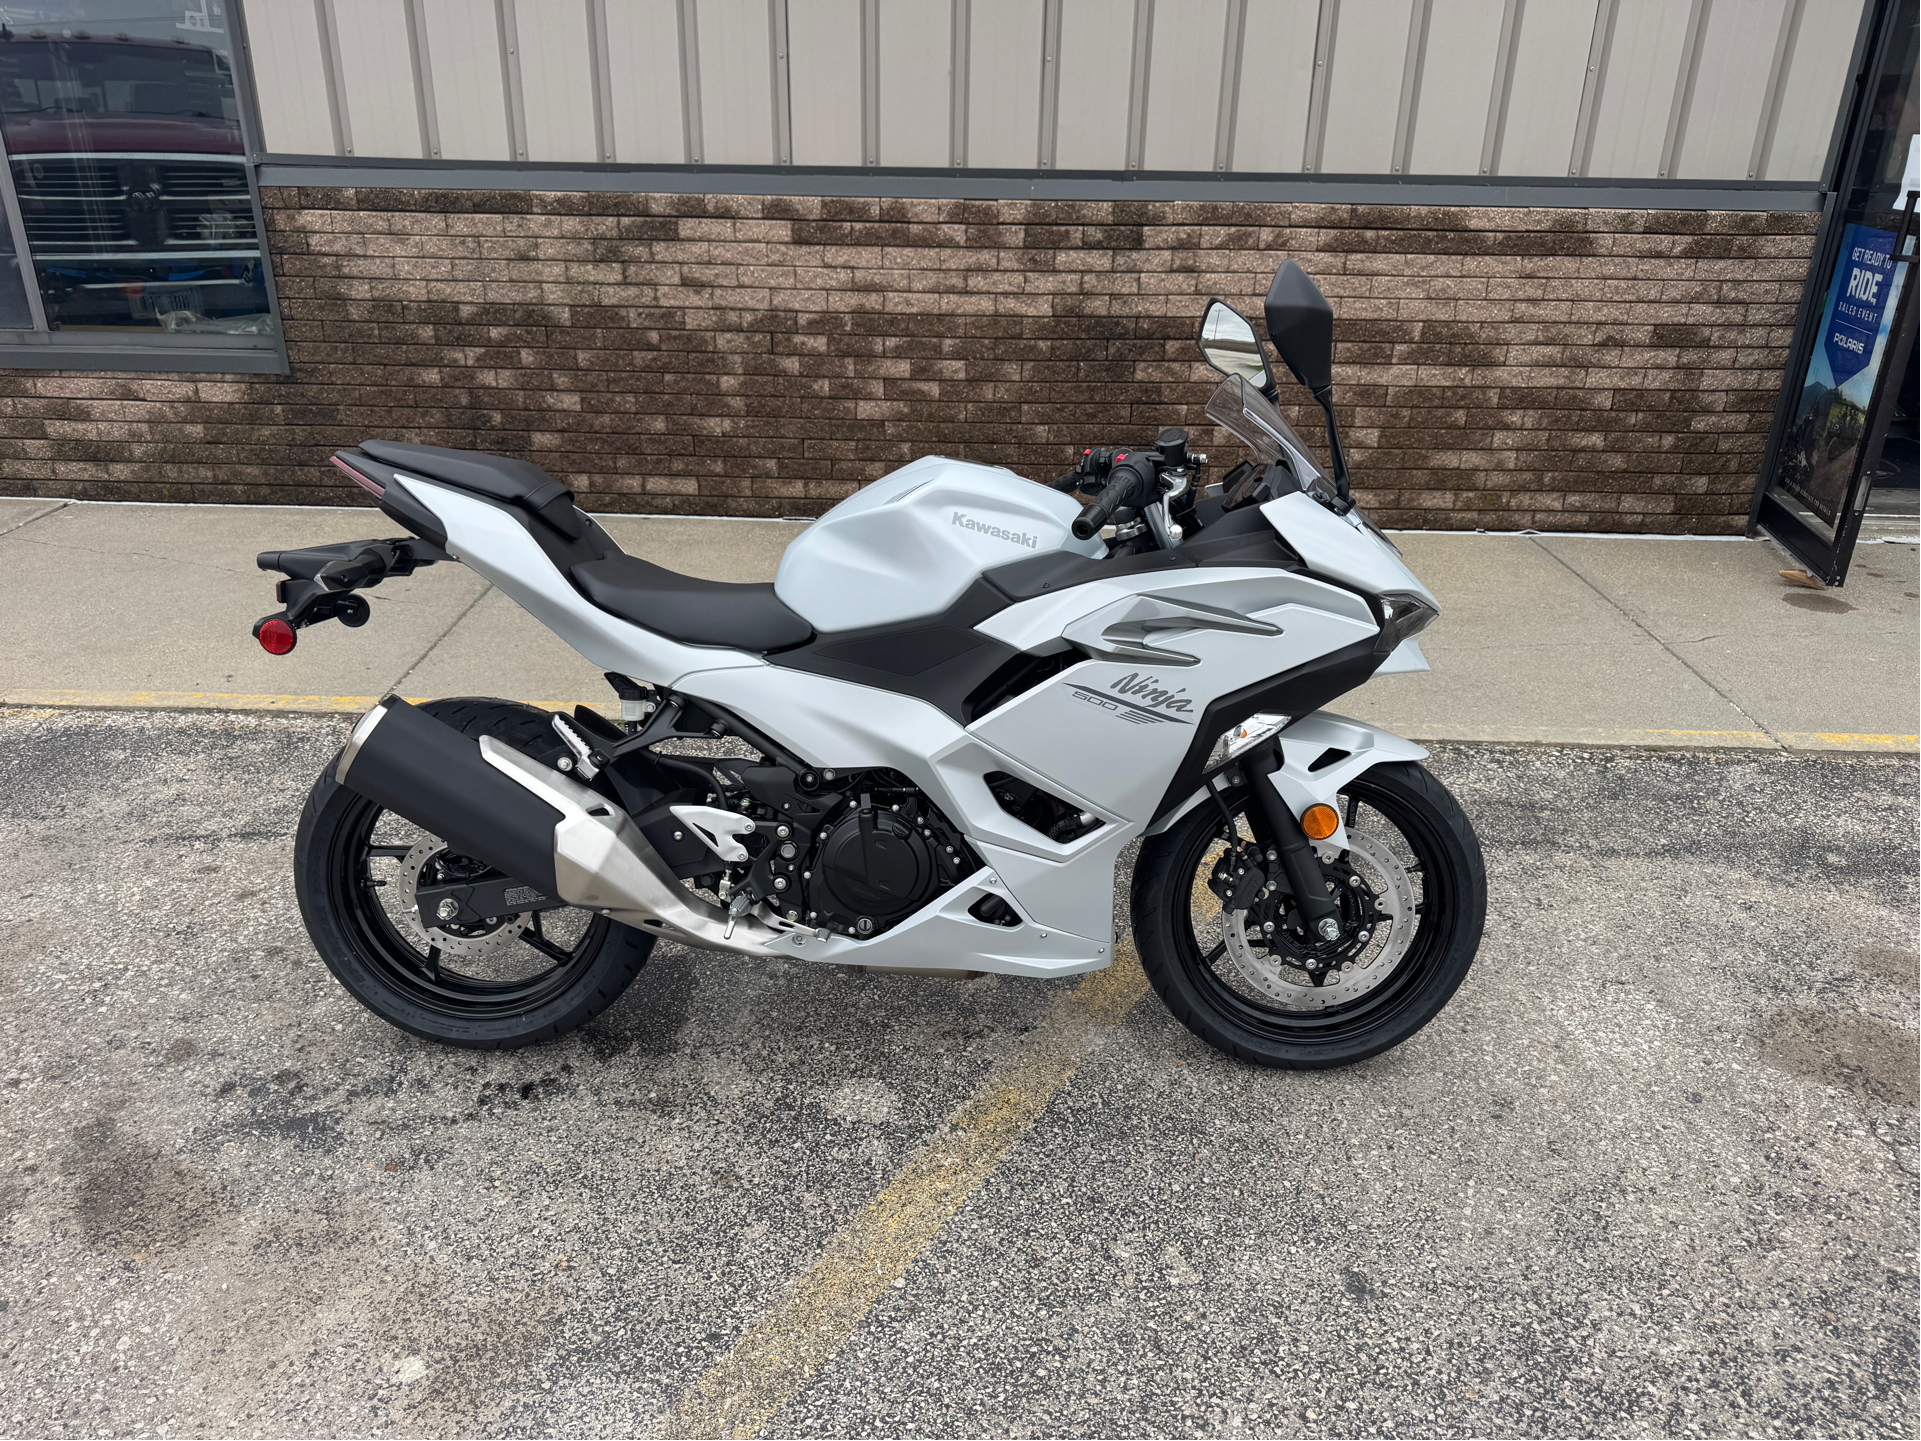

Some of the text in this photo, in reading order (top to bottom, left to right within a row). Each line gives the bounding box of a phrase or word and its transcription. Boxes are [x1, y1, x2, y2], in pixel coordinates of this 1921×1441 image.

[1852, 247, 1892, 269] GET READY TO
[1847, 267, 1883, 305] RIDE
[1838, 302, 1877, 322] SALES EVENT
[1833, 332, 1865, 355] POLARIS
[951, 511, 1038, 549] Kawasaki
[1072, 690, 1119, 711] 500
[1109, 672, 1194, 713] Ninja
